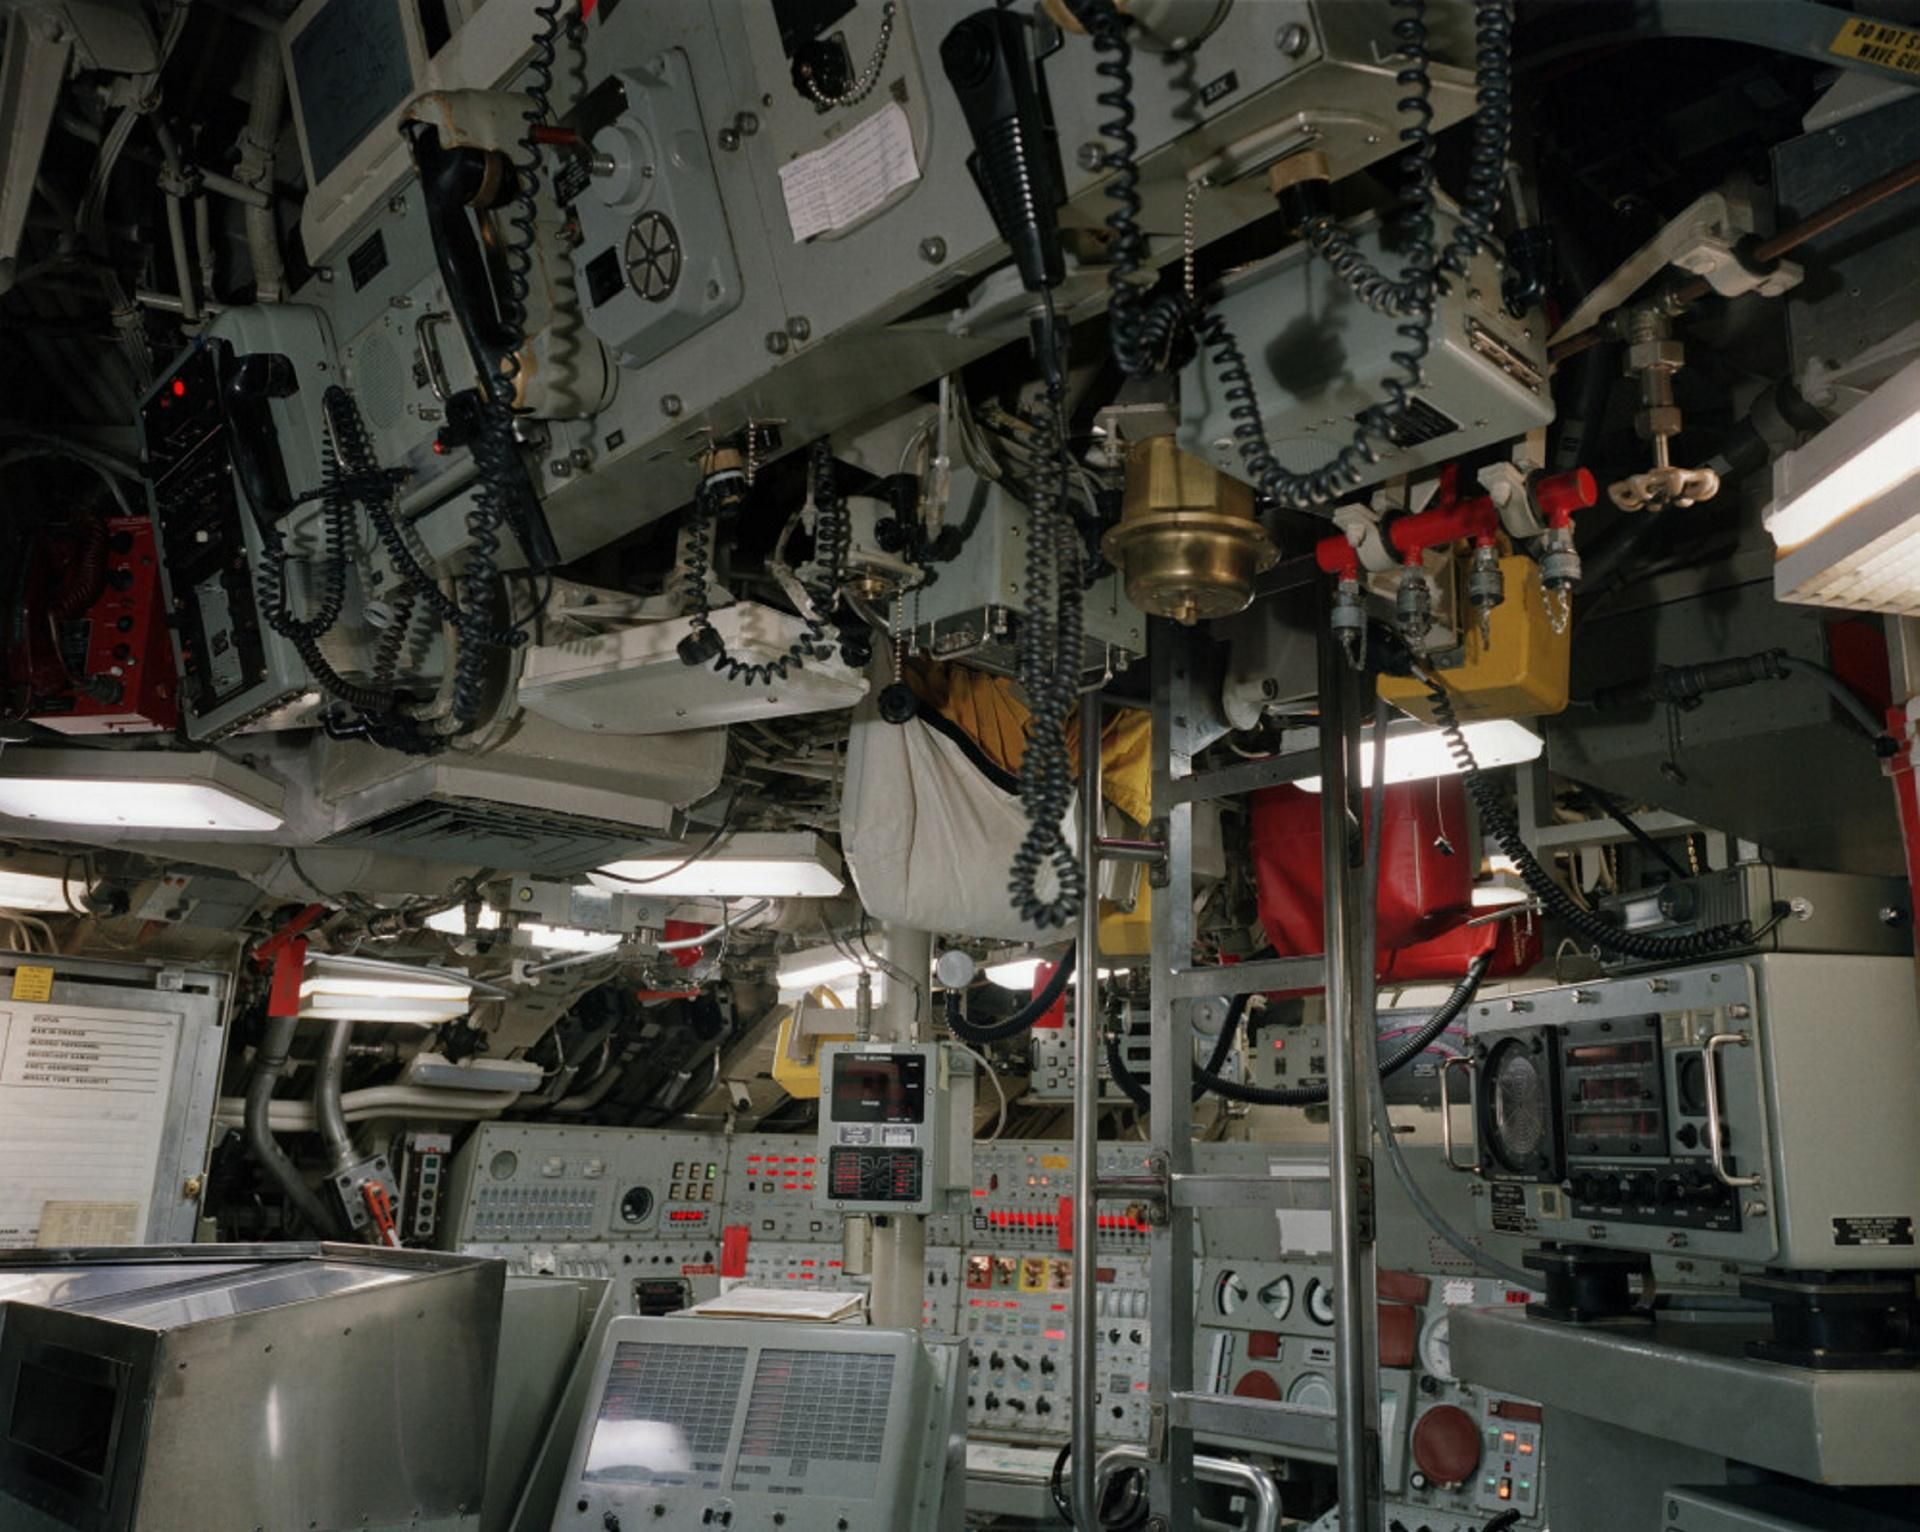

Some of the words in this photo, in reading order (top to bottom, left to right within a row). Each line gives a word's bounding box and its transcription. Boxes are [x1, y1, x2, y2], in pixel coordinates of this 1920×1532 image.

[1853, 22, 1875, 37] DO
[1875, 29, 1906, 45] NOT
[1858, 44, 1896, 63] WAVE
